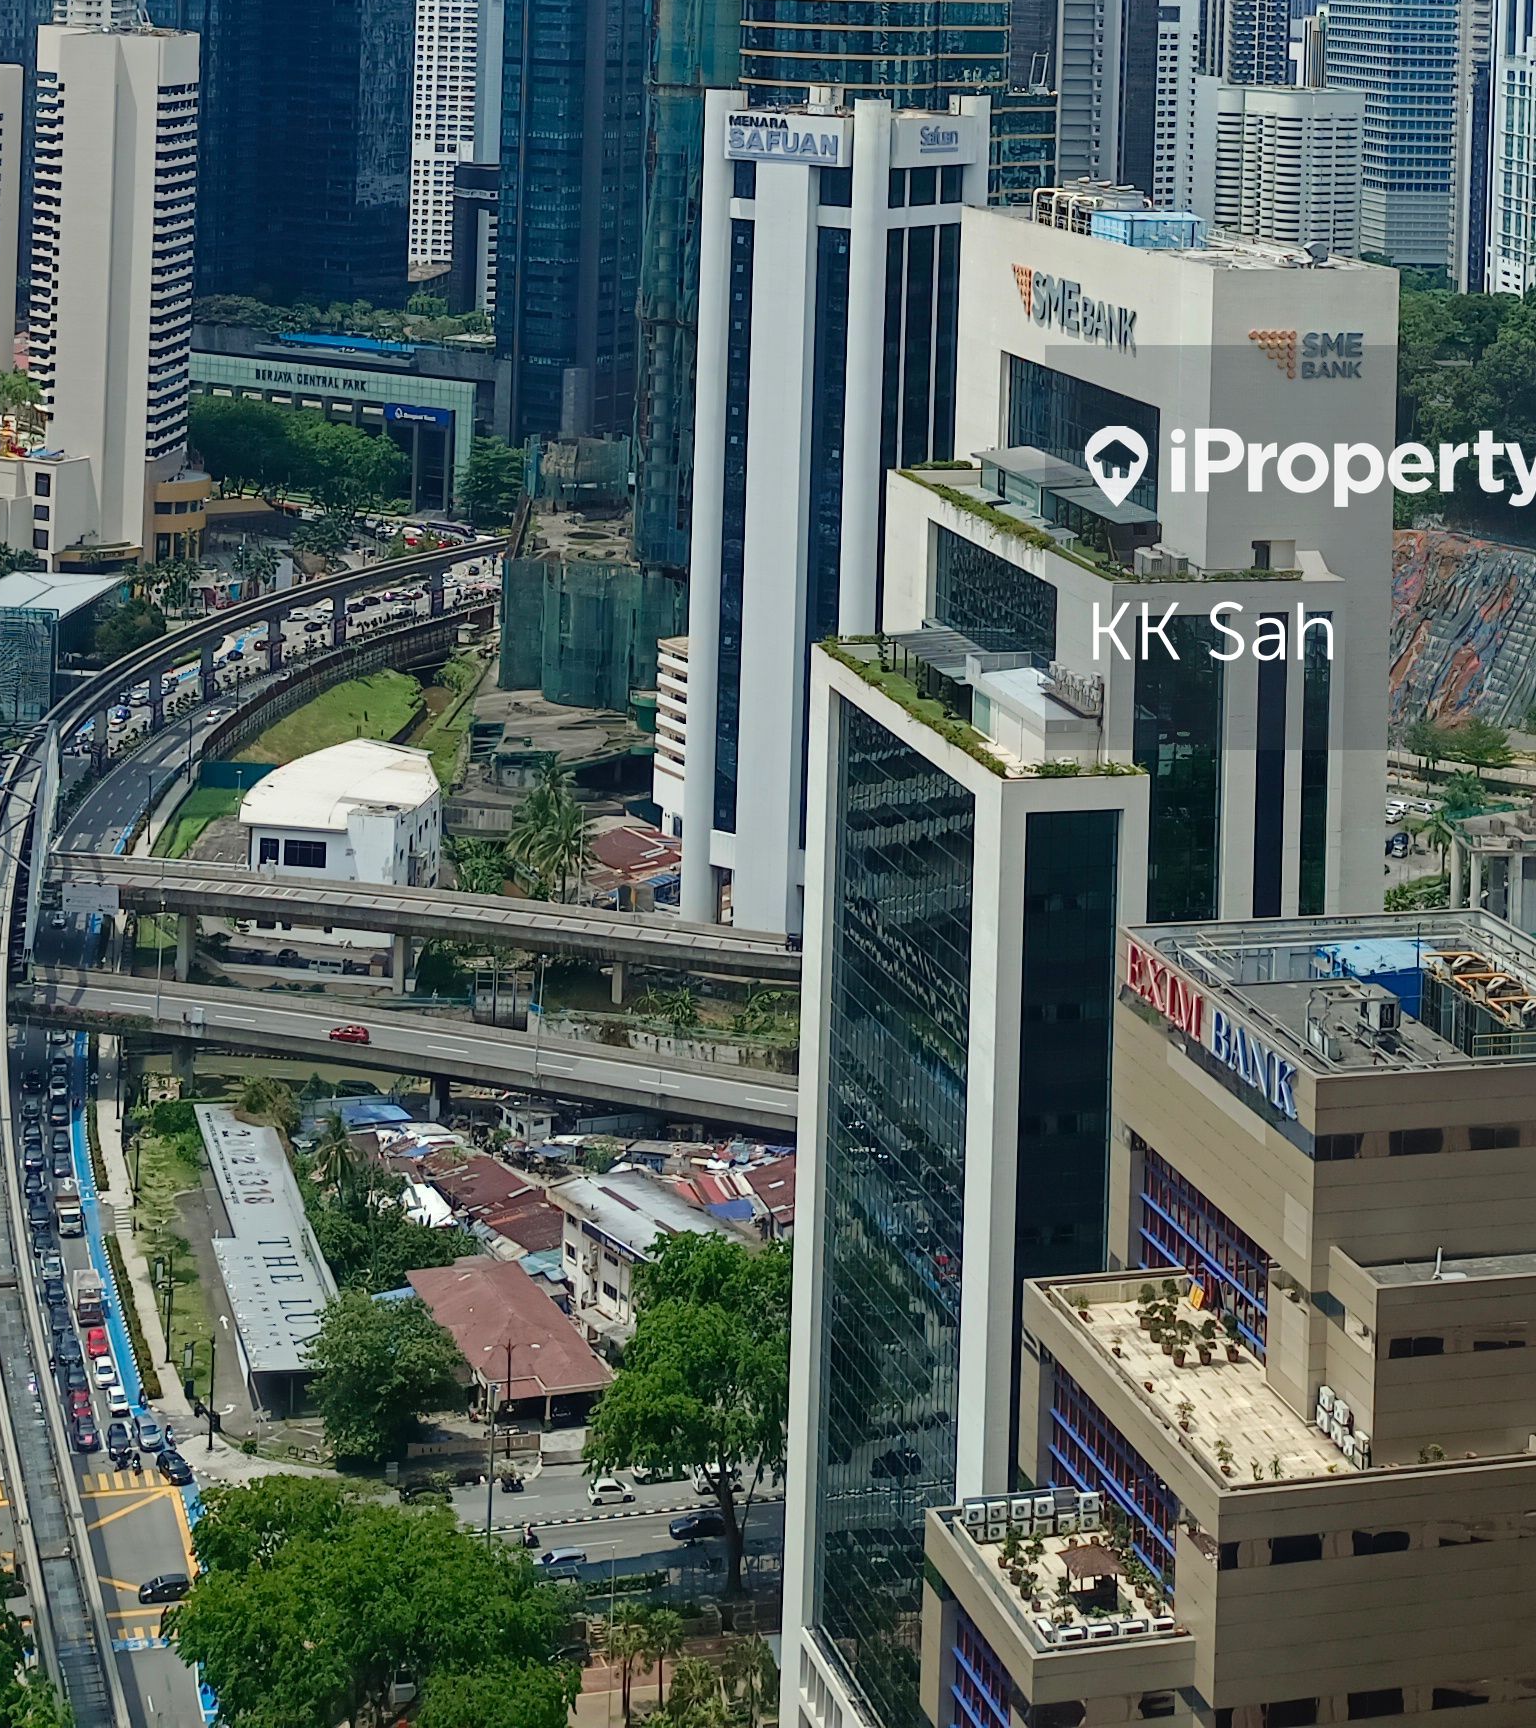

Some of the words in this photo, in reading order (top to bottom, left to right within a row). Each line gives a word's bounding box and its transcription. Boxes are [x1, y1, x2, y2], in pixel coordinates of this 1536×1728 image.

[729, 115, 789, 129] MENARA
[728, 128, 839, 156] SAFUAN
[920, 125, 959, 146] Safuan
[1031, 271, 1080, 340] SME
[1081, 296, 1138, 358] BANK
[1301, 332, 1364, 358] SME
[255, 368, 292, 384] BERJAYA
[296, 373, 339, 389] CENTRAL
[342, 378, 368, 392] PARK
[1301, 360, 1363, 379] BANK
[1126, 939, 1204, 1042] EXIM
[1211, 1008, 1298, 1120] BANK
[257, 1236, 305, 1285] THE
